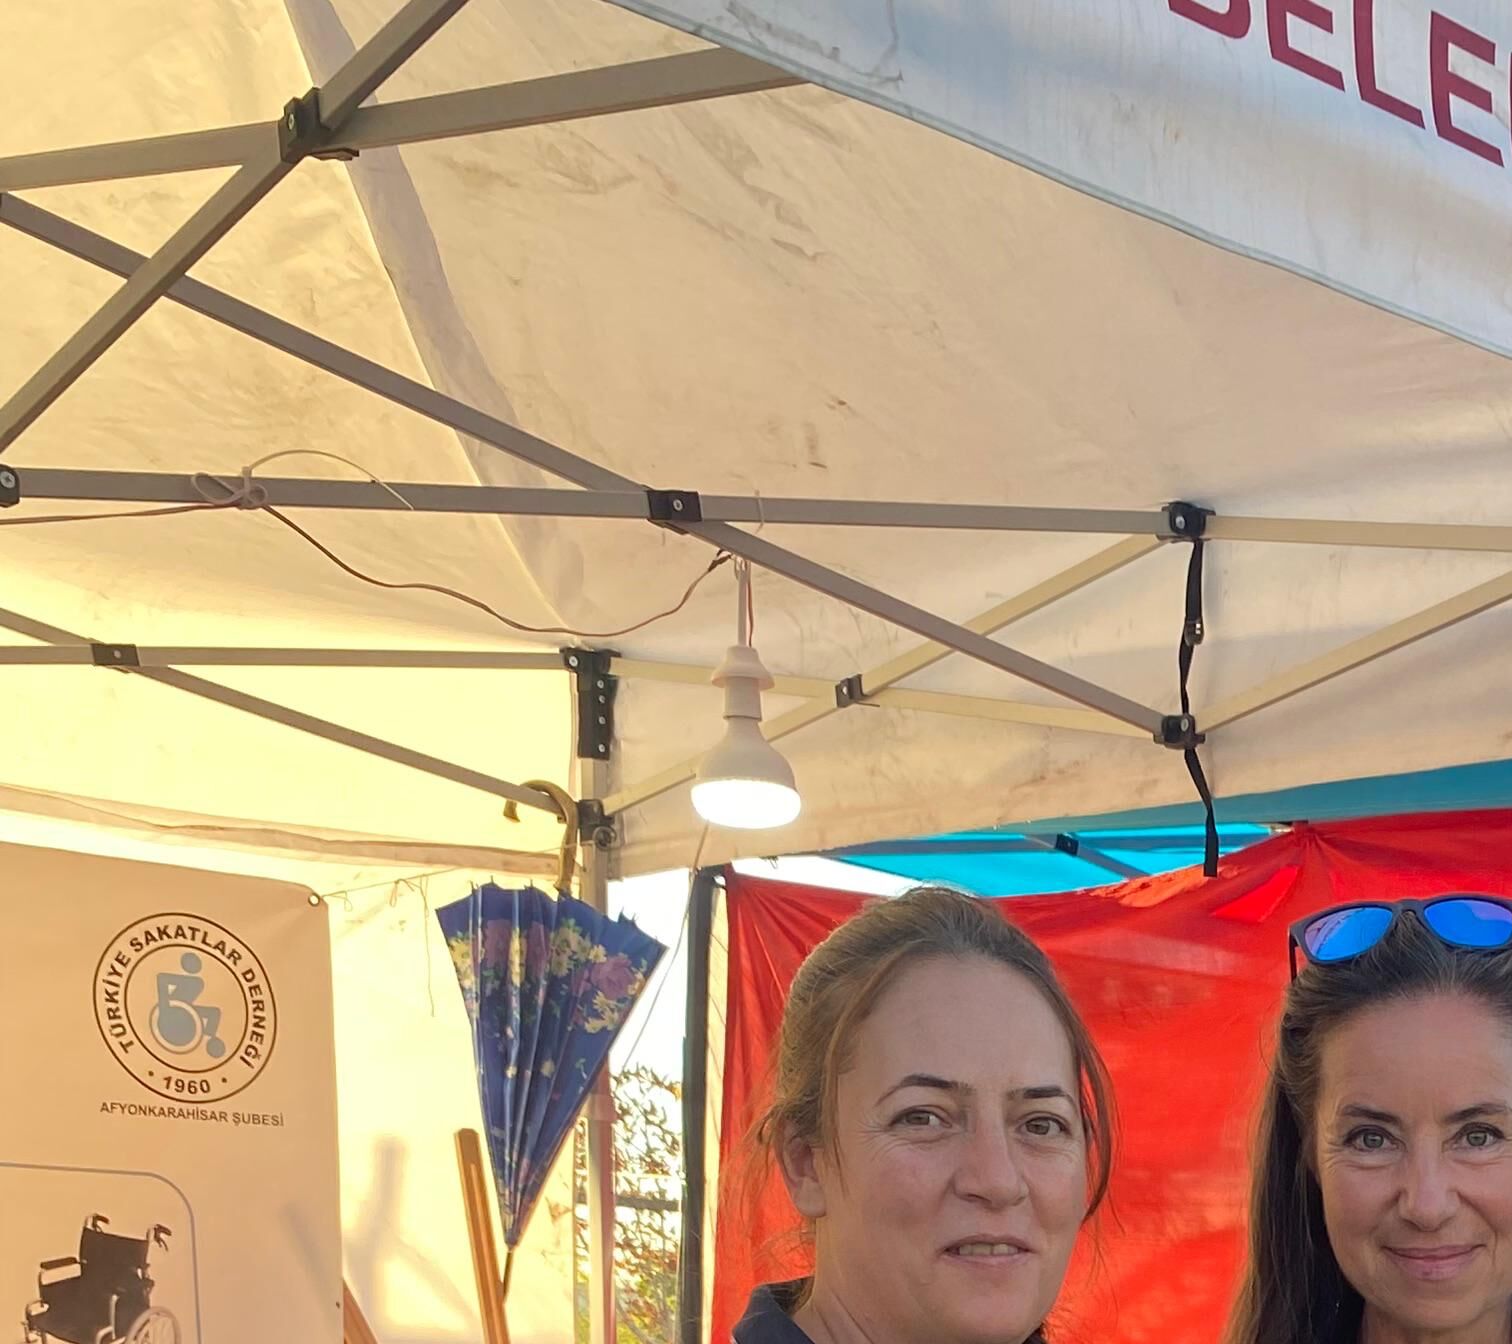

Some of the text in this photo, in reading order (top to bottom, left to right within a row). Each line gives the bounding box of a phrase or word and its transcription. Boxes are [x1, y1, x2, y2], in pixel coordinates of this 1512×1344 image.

[103, 923, 267, 1070] TÜRKİYE SAKATLAR DERNEĞİ
[161, 1074, 212, 1096] 1960
[100, 1101, 285, 1127] AFYONKARAHİSAR ŞUBESİ
